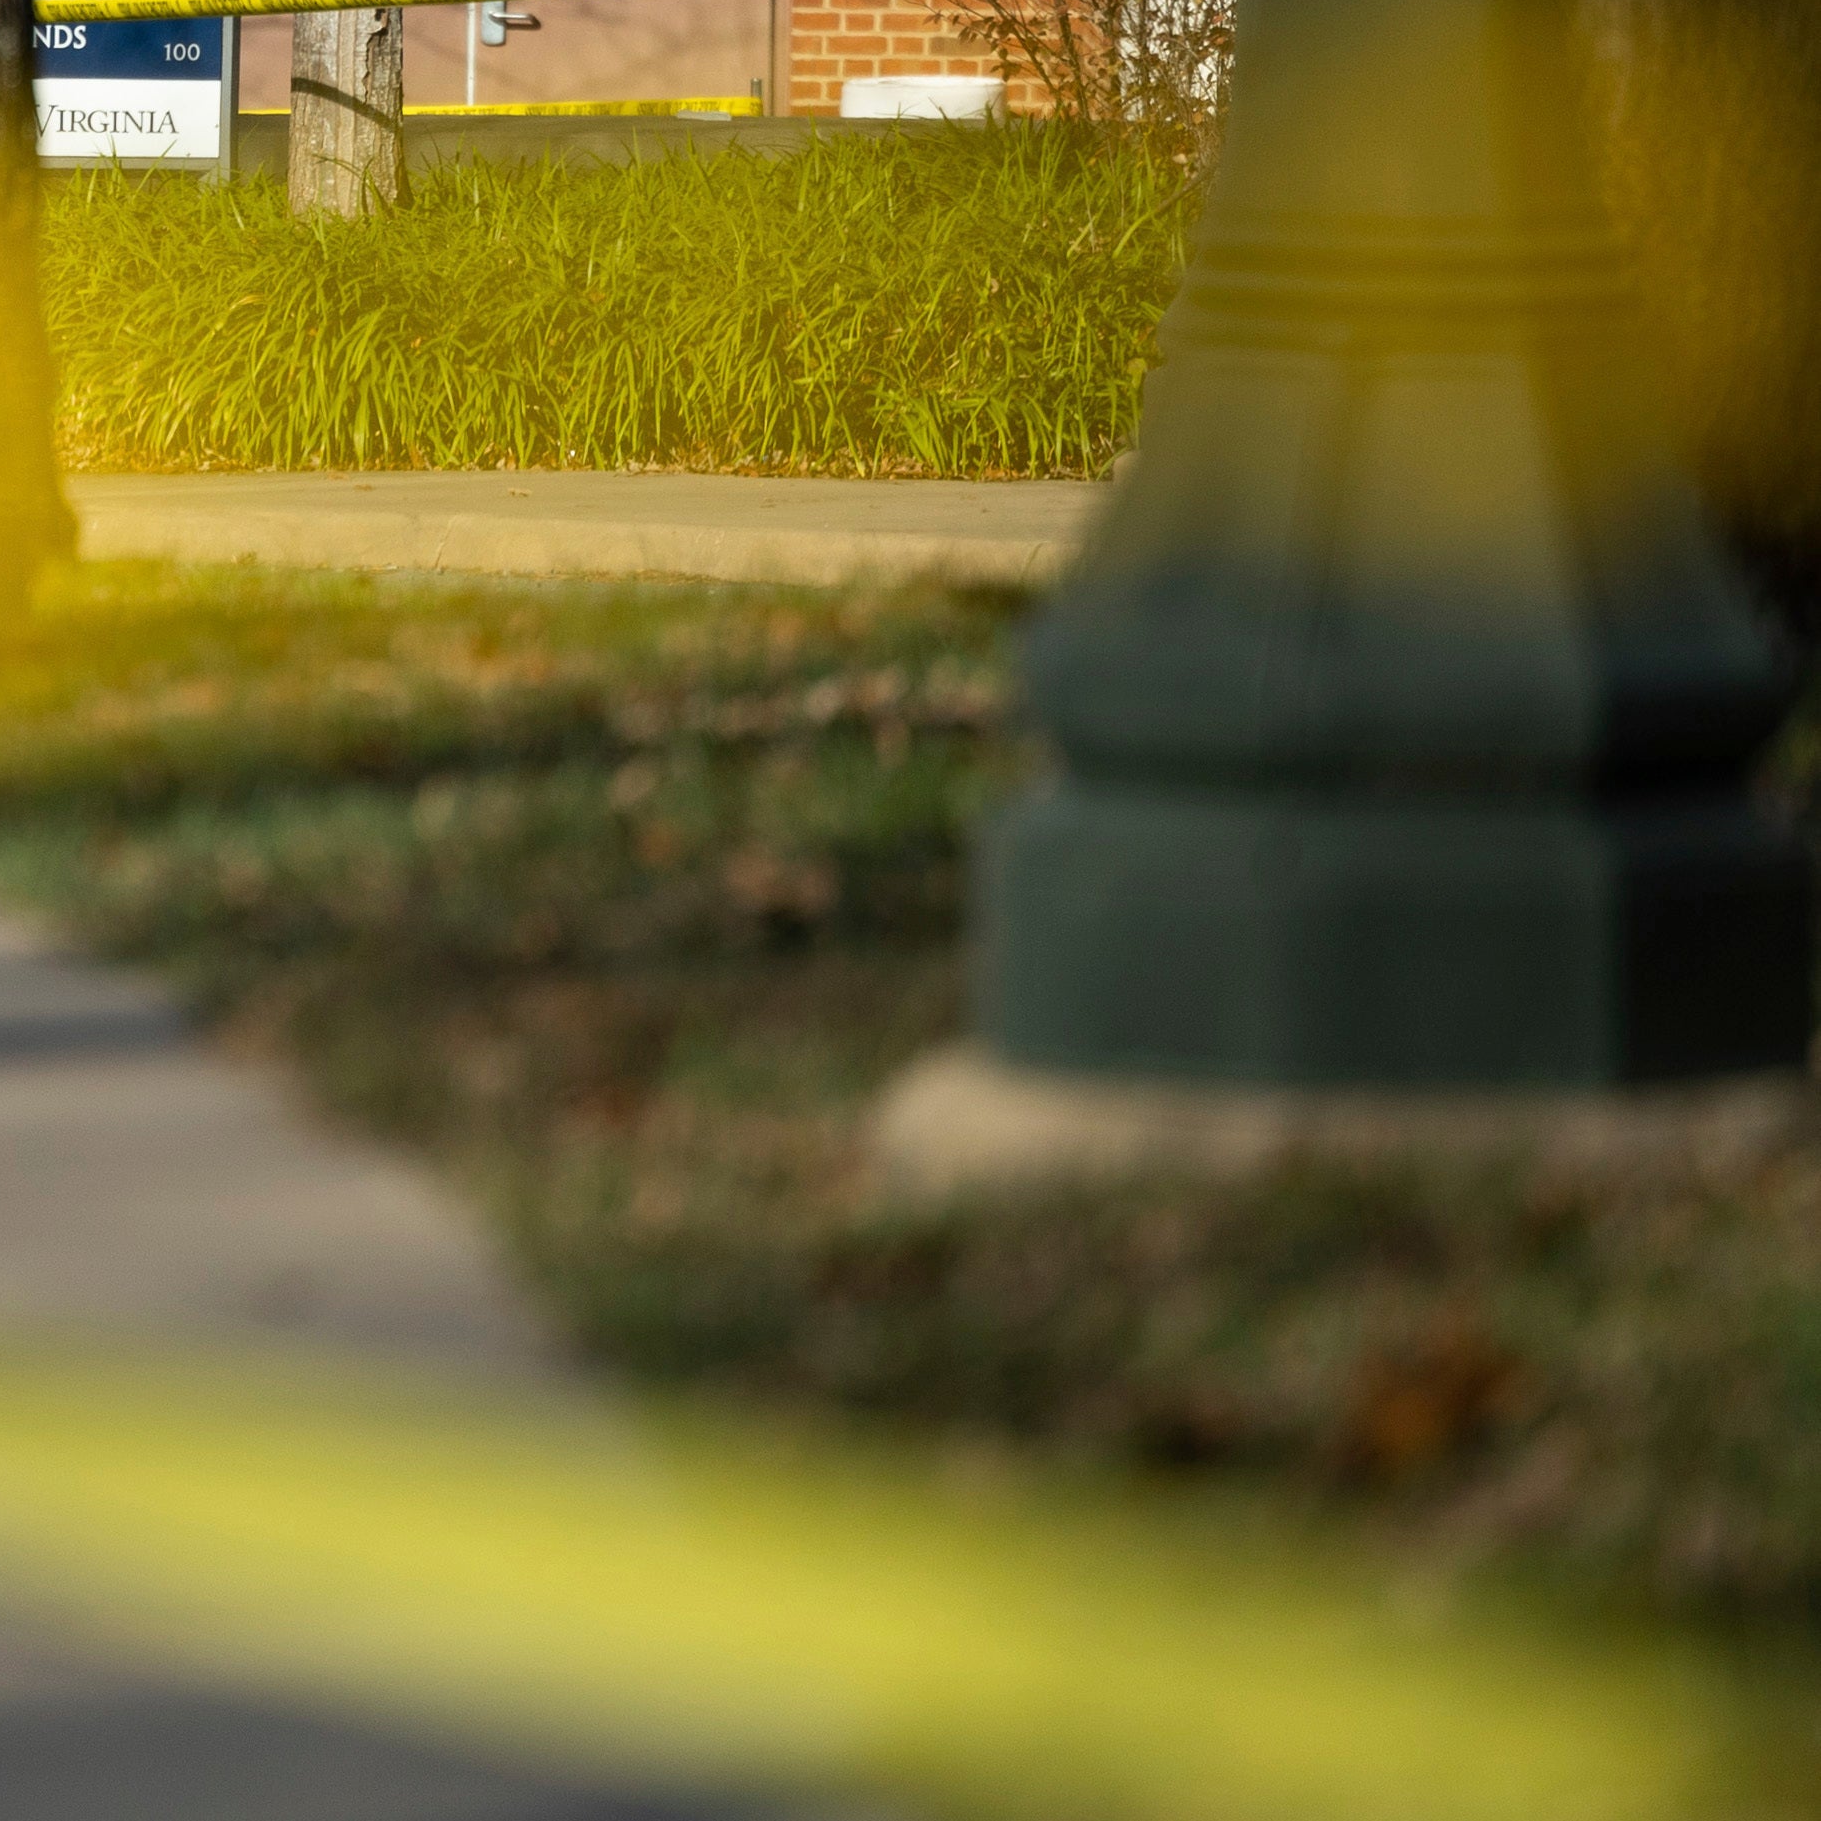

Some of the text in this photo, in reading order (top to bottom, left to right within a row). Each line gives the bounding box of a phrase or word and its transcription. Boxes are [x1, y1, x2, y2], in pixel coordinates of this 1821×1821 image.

[33, 24, 88, 50] NDS
[163, 43, 201, 62] 100
[34, 103, 180, 138] VIRGINIA
